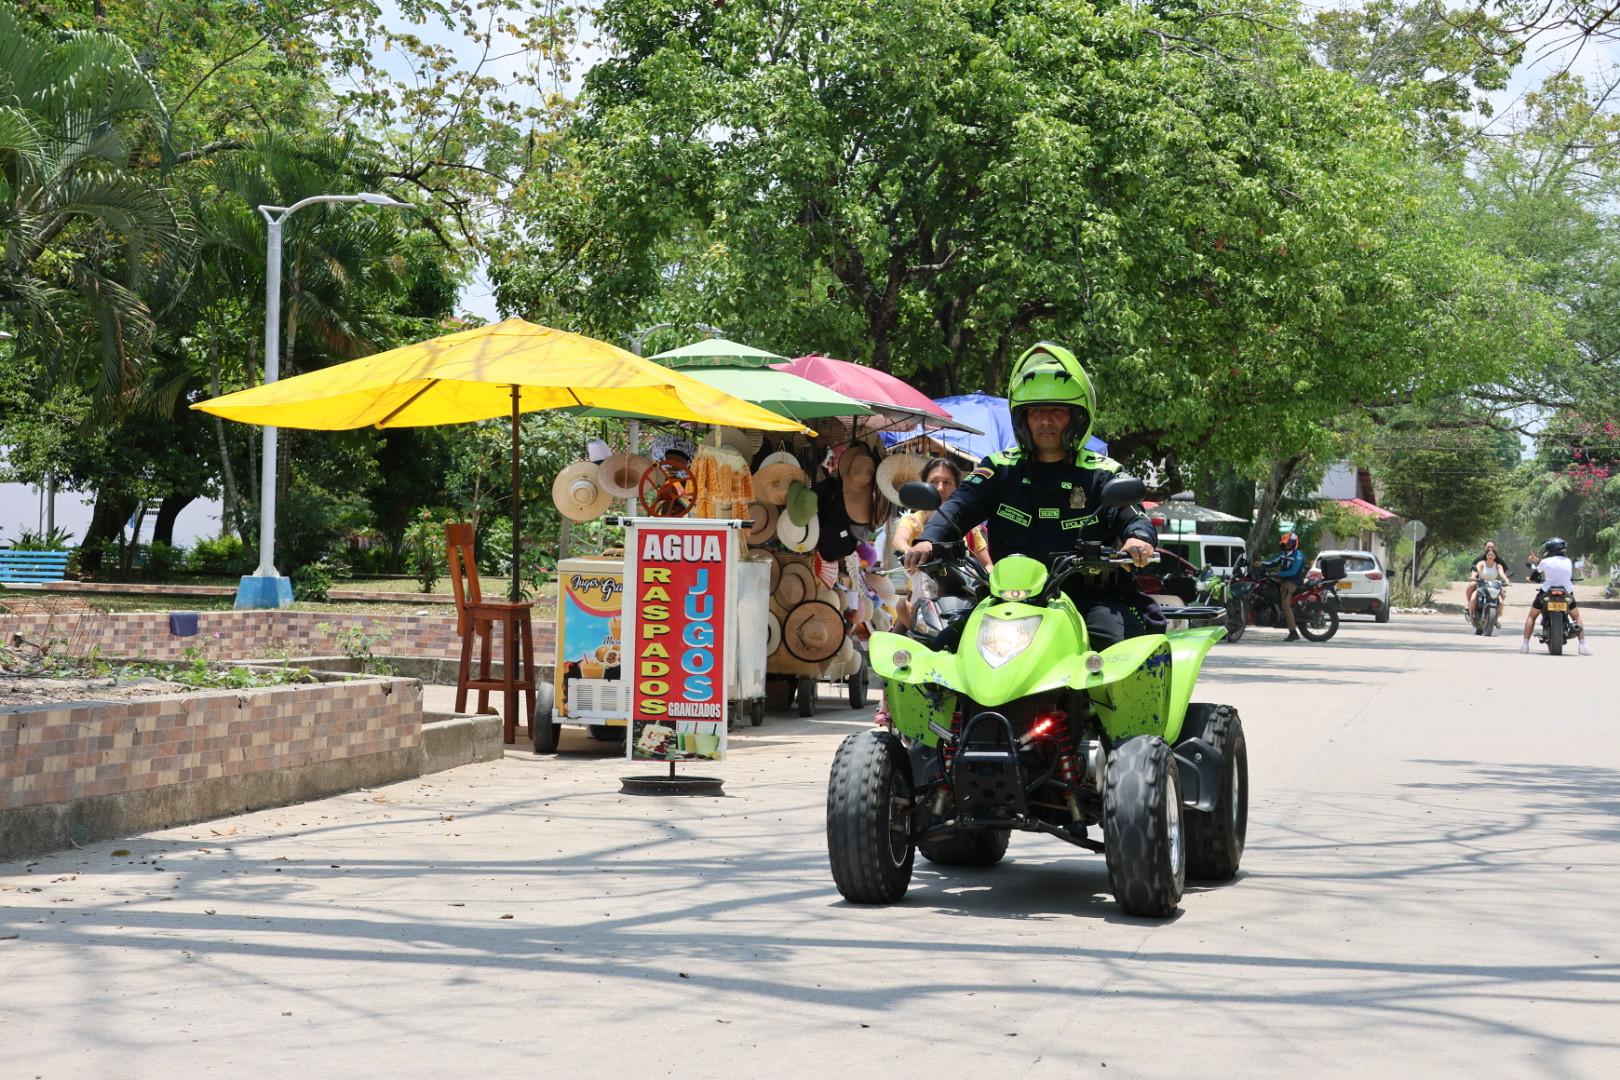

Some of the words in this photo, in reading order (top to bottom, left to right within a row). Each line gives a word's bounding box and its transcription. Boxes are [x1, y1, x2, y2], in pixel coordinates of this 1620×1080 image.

[642, 534, 722, 563] AGUA
[571, 575, 599, 593] Jugos
[639, 567, 671, 715] RASPADOS
[681, 569, 714, 702] JUGOS
[668, 702, 721, 719] GRANIZADOS
